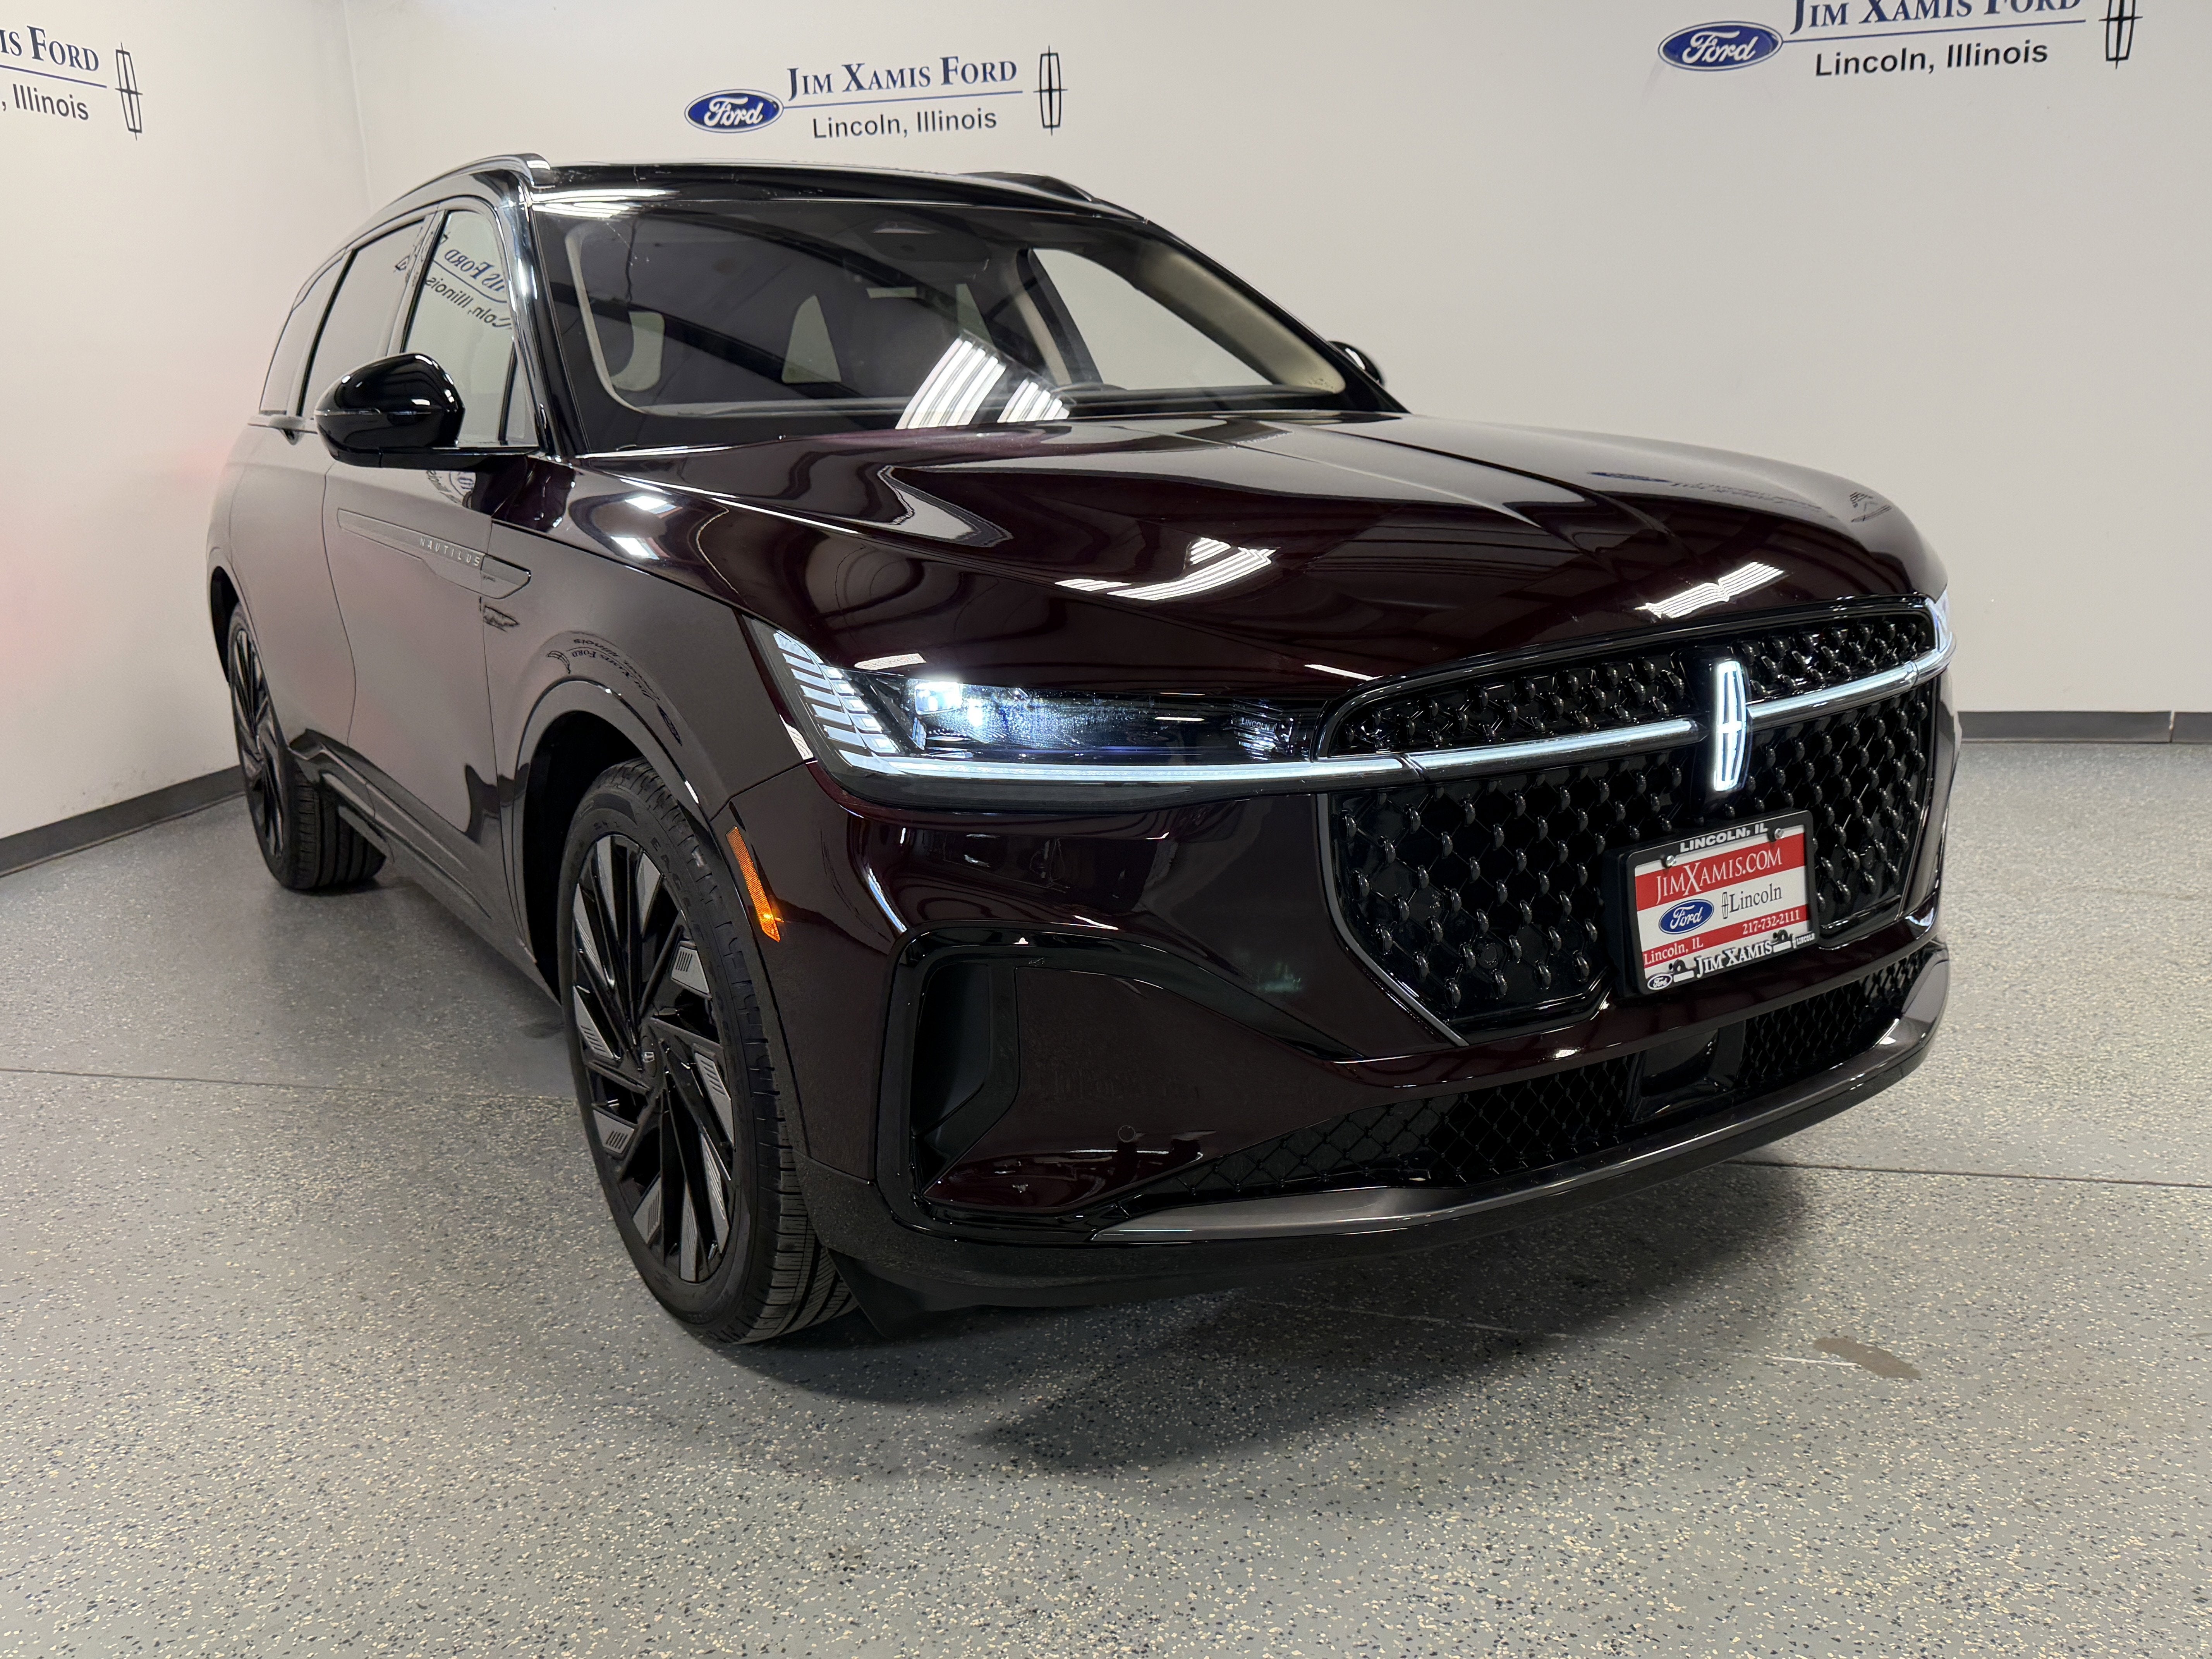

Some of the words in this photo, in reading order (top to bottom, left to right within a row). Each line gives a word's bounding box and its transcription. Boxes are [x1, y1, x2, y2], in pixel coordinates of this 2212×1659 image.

[27, 25, 99, 71] FORD
[1681, 30, 1758, 64] Ford
[1815, 48, 1934, 76] Lincoln,
[1947, 40, 2048, 68] Illinois
[787, 67, 834, 101] JIM
[842, 63, 931, 92] XAMIS
[940, 56, 1017, 86] FORD
[13, 83, 89, 120] Illinois
[704, 96, 764, 126] Ford
[813, 114, 907, 139] Lincoln,
[917, 108, 997, 132] Illinois
[420, 537, 481, 567] NAUTILUS
[1241, 717, 1270, 731] LINCOLN
[1680, 827, 1751, 852] LINCOLN,
[1755, 823, 1768, 835] IL
[1656, 847, 1782, 904] JIMXAMIS.COM
[1729, 883, 1782, 913] Lincoln
[1670, 904, 1702, 929] Ford
[1742, 910, 1800, 935] 217-732-2111
[1644, 942, 1689, 965] Lincoln,
[1692, 937, 1703, 949] IL
[1696, 957, 1724, 978] JIM
[1726, 941, 1772, 967] XAMIS
